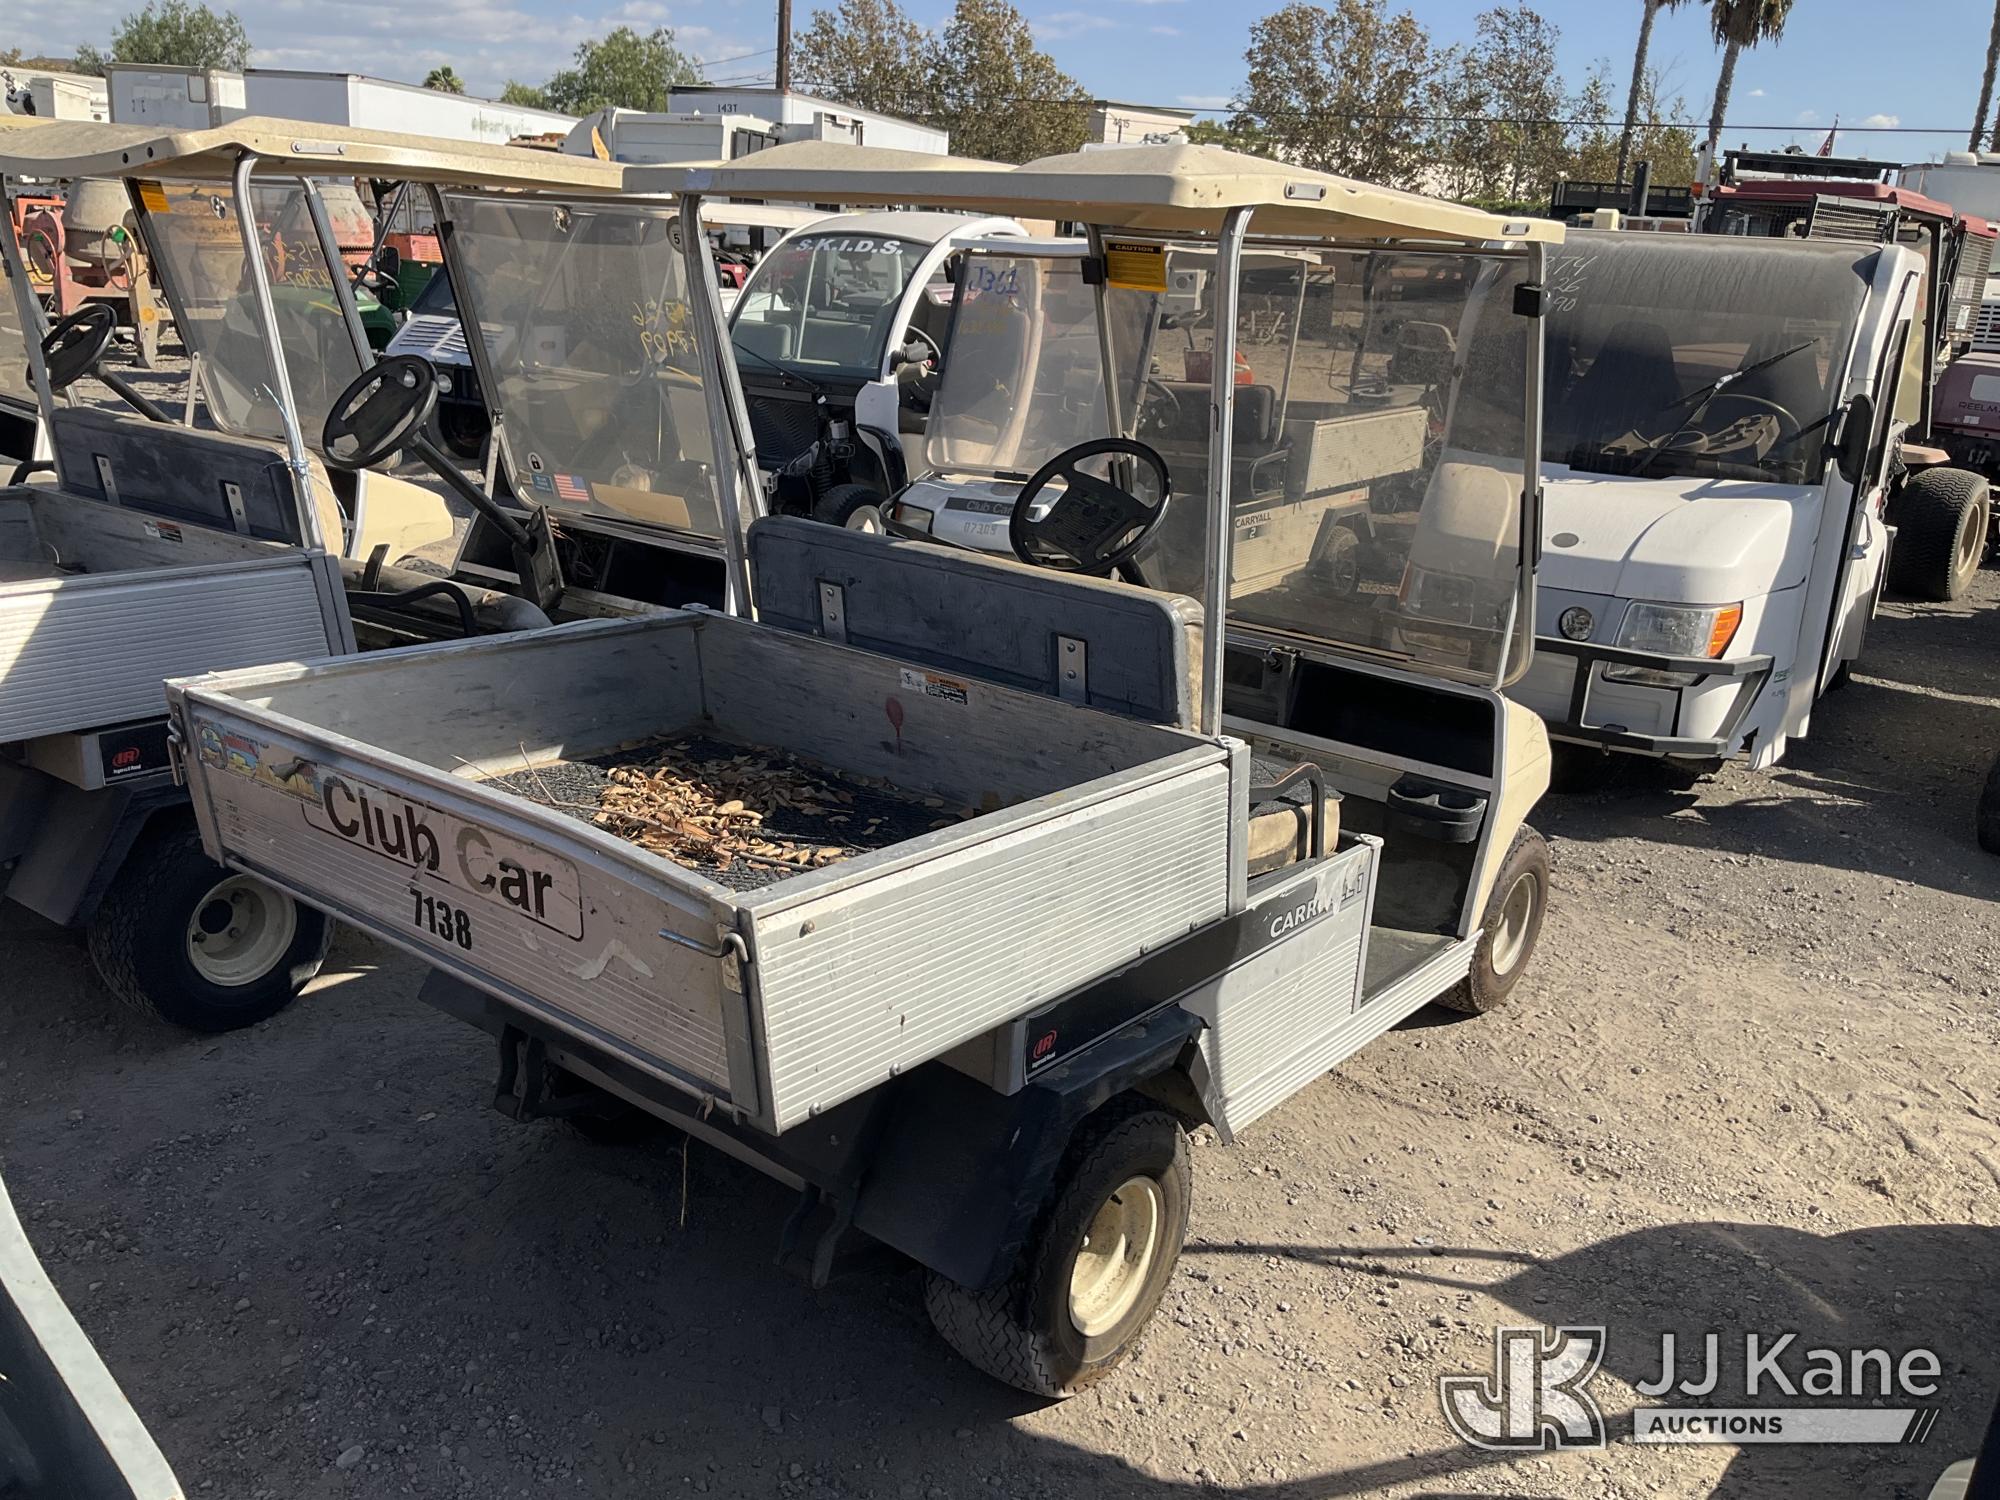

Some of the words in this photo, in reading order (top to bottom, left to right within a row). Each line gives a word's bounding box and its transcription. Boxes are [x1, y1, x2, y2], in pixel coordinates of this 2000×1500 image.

[717, 103, 738, 113] 143T
[796, 238, 904, 255] S.K.I.D.S.
[1115, 244, 1154, 253] CAUTION
[1958, 402, 2000, 413] REELM
[967, 501, 991, 512] Club
[1235, 512, 1271, 528] CARRYALL
[1249, 527, 1256, 538] 2
[323, 775, 441, 871] Club
[456, 827, 553, 919] Car
[409, 887, 473, 950] 7138
